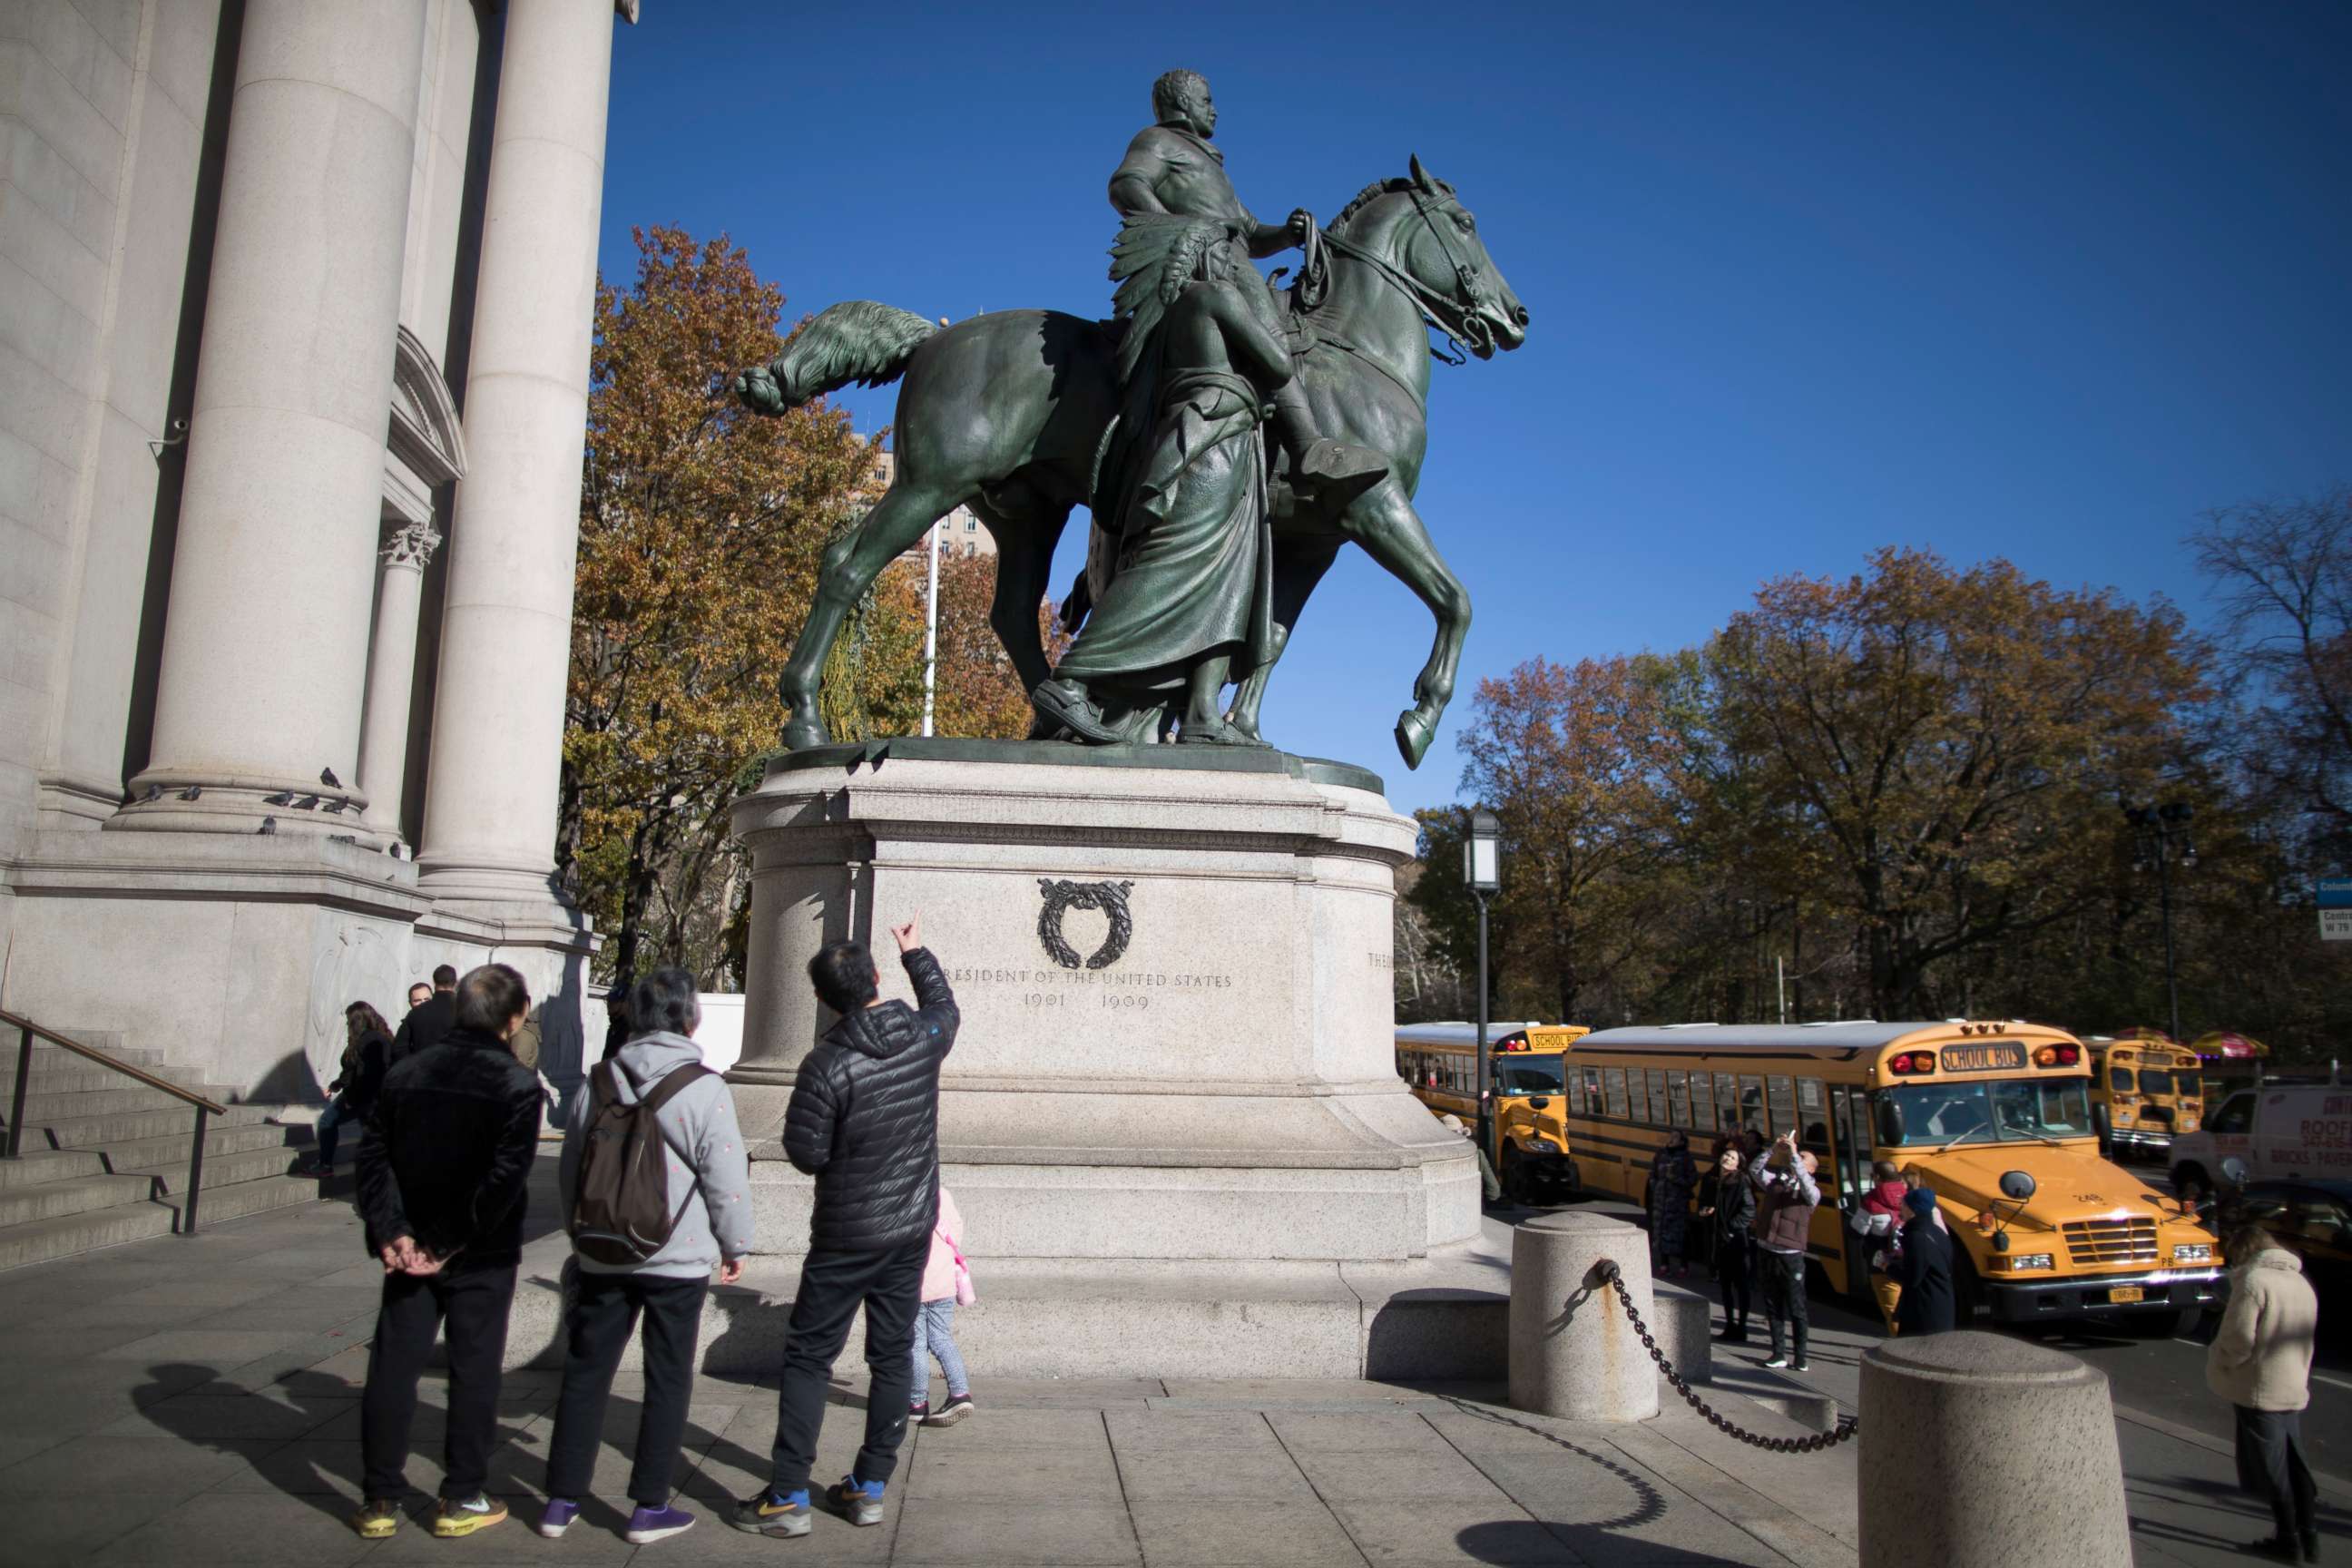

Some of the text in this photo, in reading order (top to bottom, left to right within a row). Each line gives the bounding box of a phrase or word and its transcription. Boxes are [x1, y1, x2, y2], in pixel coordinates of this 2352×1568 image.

[944, 968, 1232, 988] RESIDENT OF THE UNITED STATES
[1025, 993, 1148, 1010] 1901 1909
[1535, 1035, 1564, 1046] SCHOOL
[1943, 1047, 2019, 1070] SCHOOL BUS
[2301, 1120, 2352, 1135] ROOF
